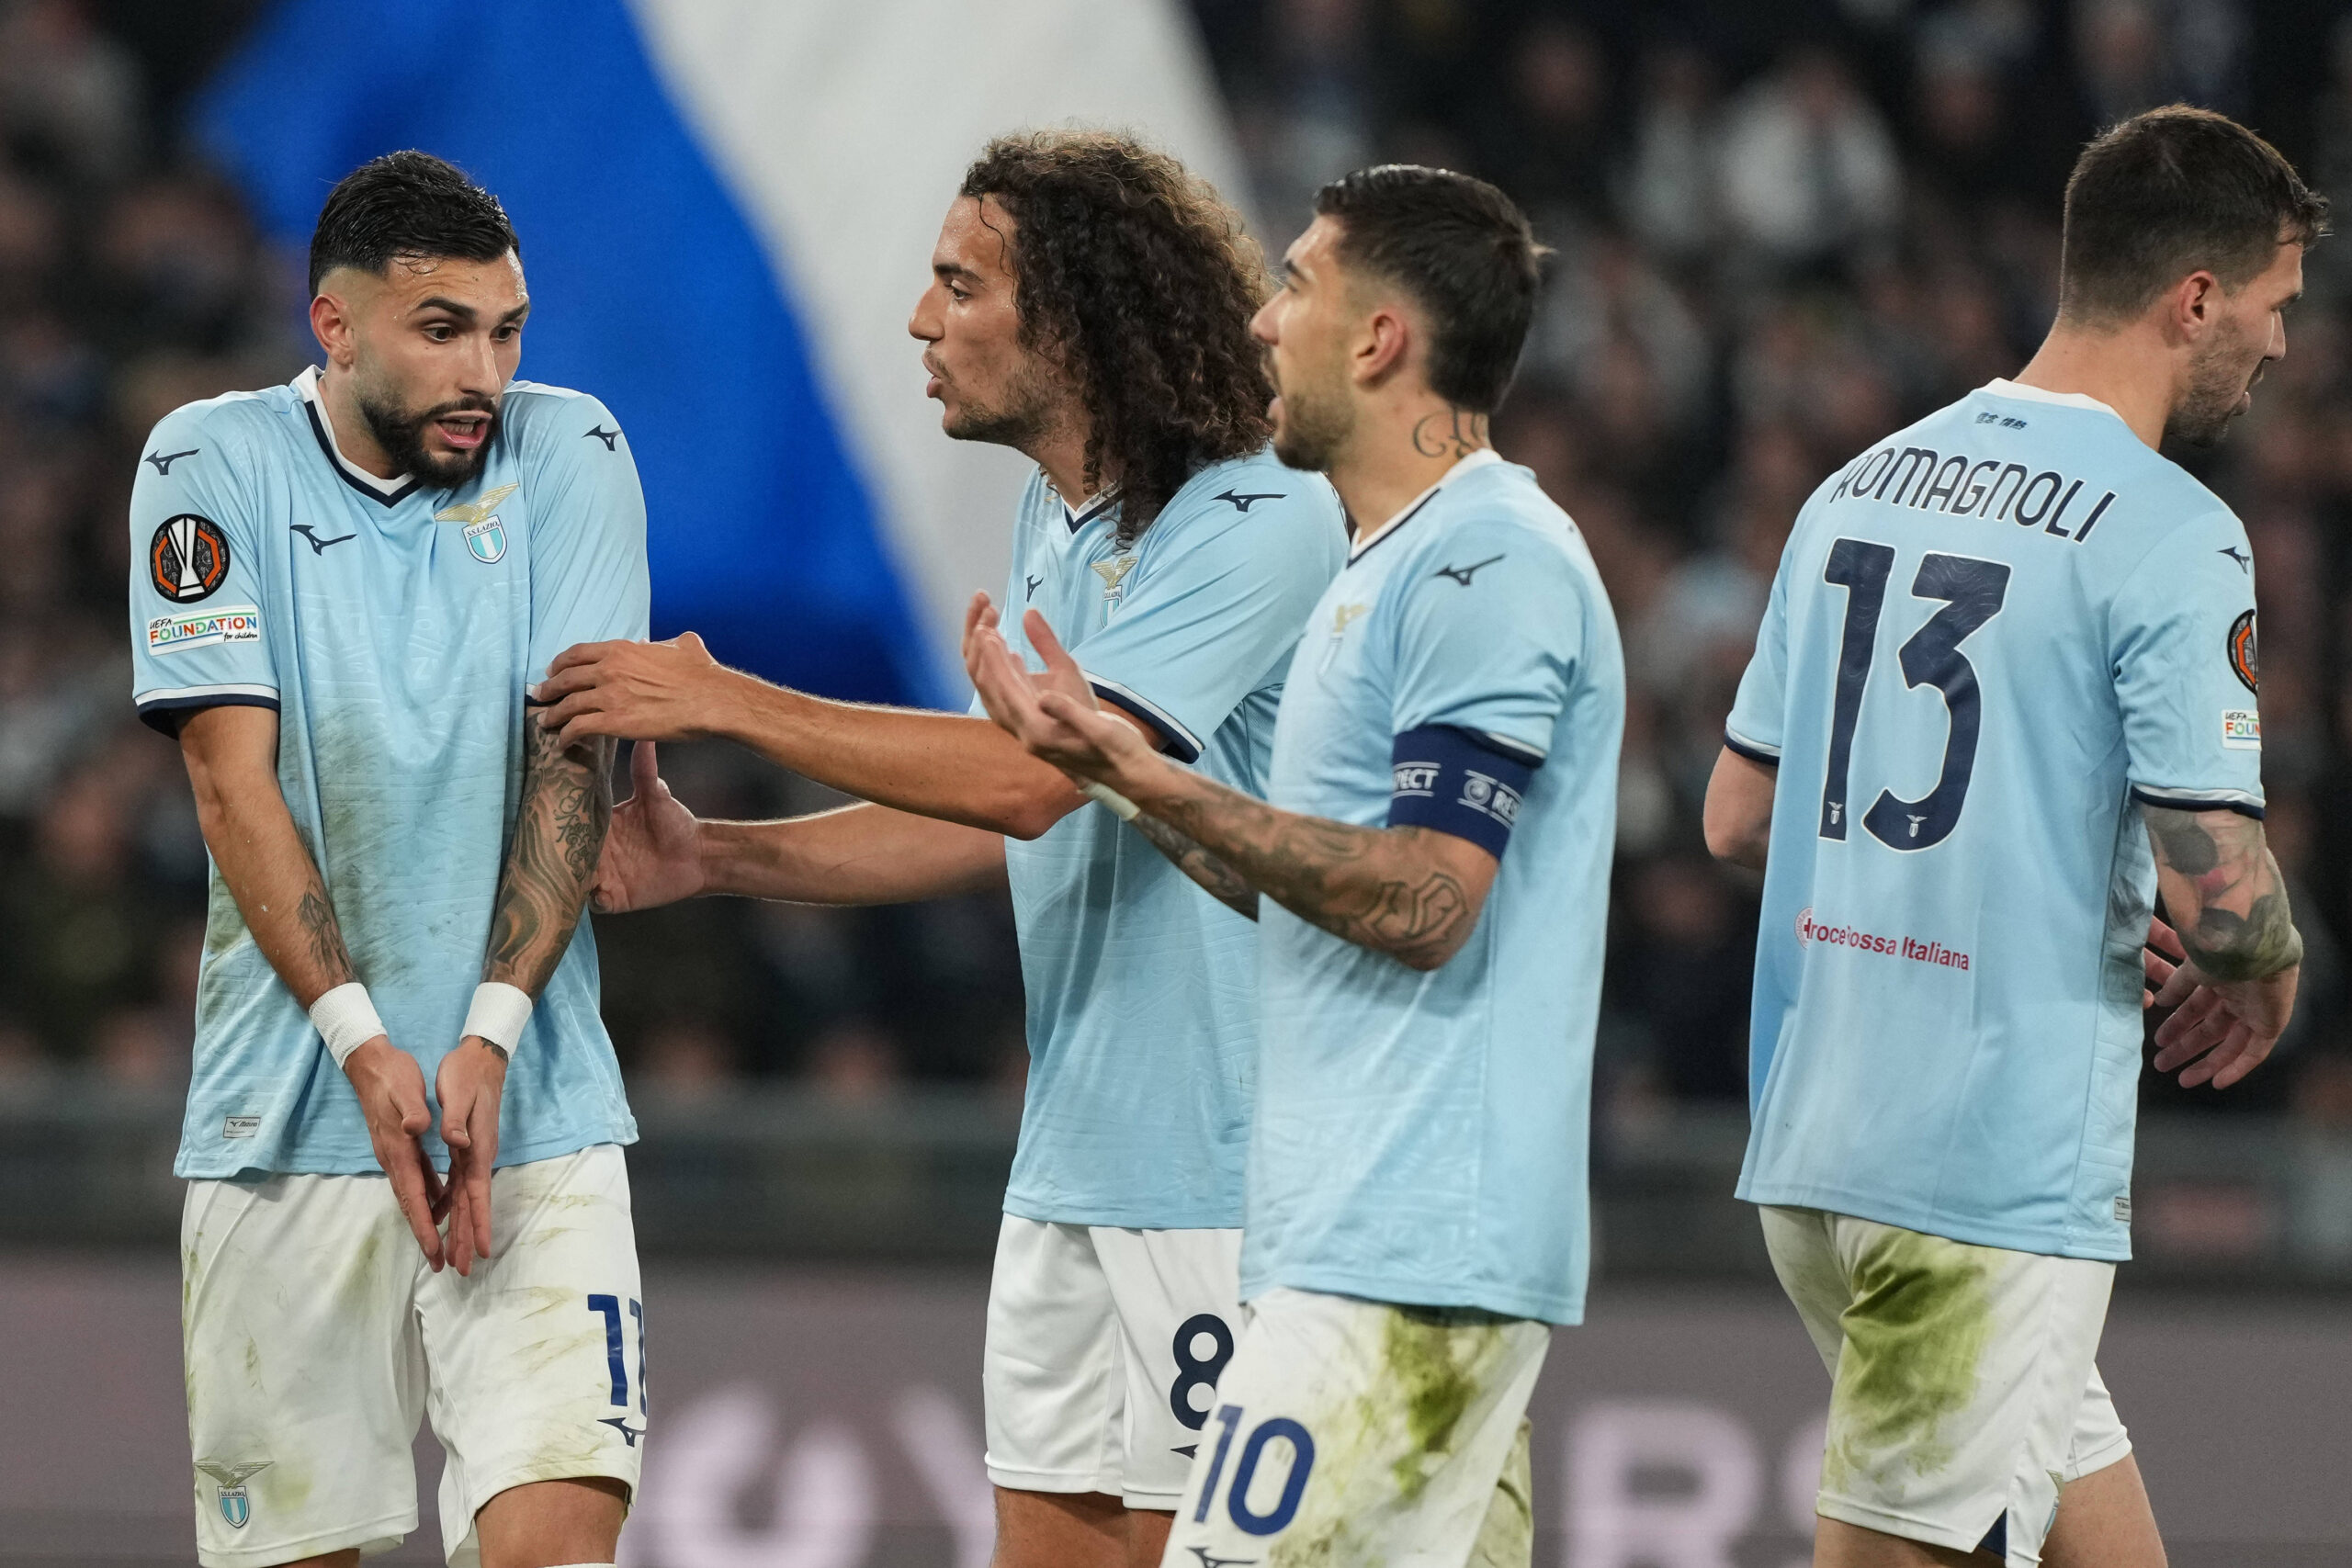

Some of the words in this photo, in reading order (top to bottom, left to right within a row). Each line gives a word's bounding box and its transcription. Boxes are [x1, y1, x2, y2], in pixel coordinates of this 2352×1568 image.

[1828, 446, 2117, 544] ROMAGNOLI
[150, 618, 173, 630] UEFA
[223, 633, 232, 642] for
[234, 632, 258, 640] children
[1818, 536, 2012, 852] 13
[2225, 712, 2247, 721] UEFA
[1811, 922, 1846, 946] roce
[1848, 925, 1896, 955] ossa
[1901, 936, 1969, 971] Italiana
[1170, 1314, 1235, 1431] 8
[1194, 1404, 1316, 1536] 10
